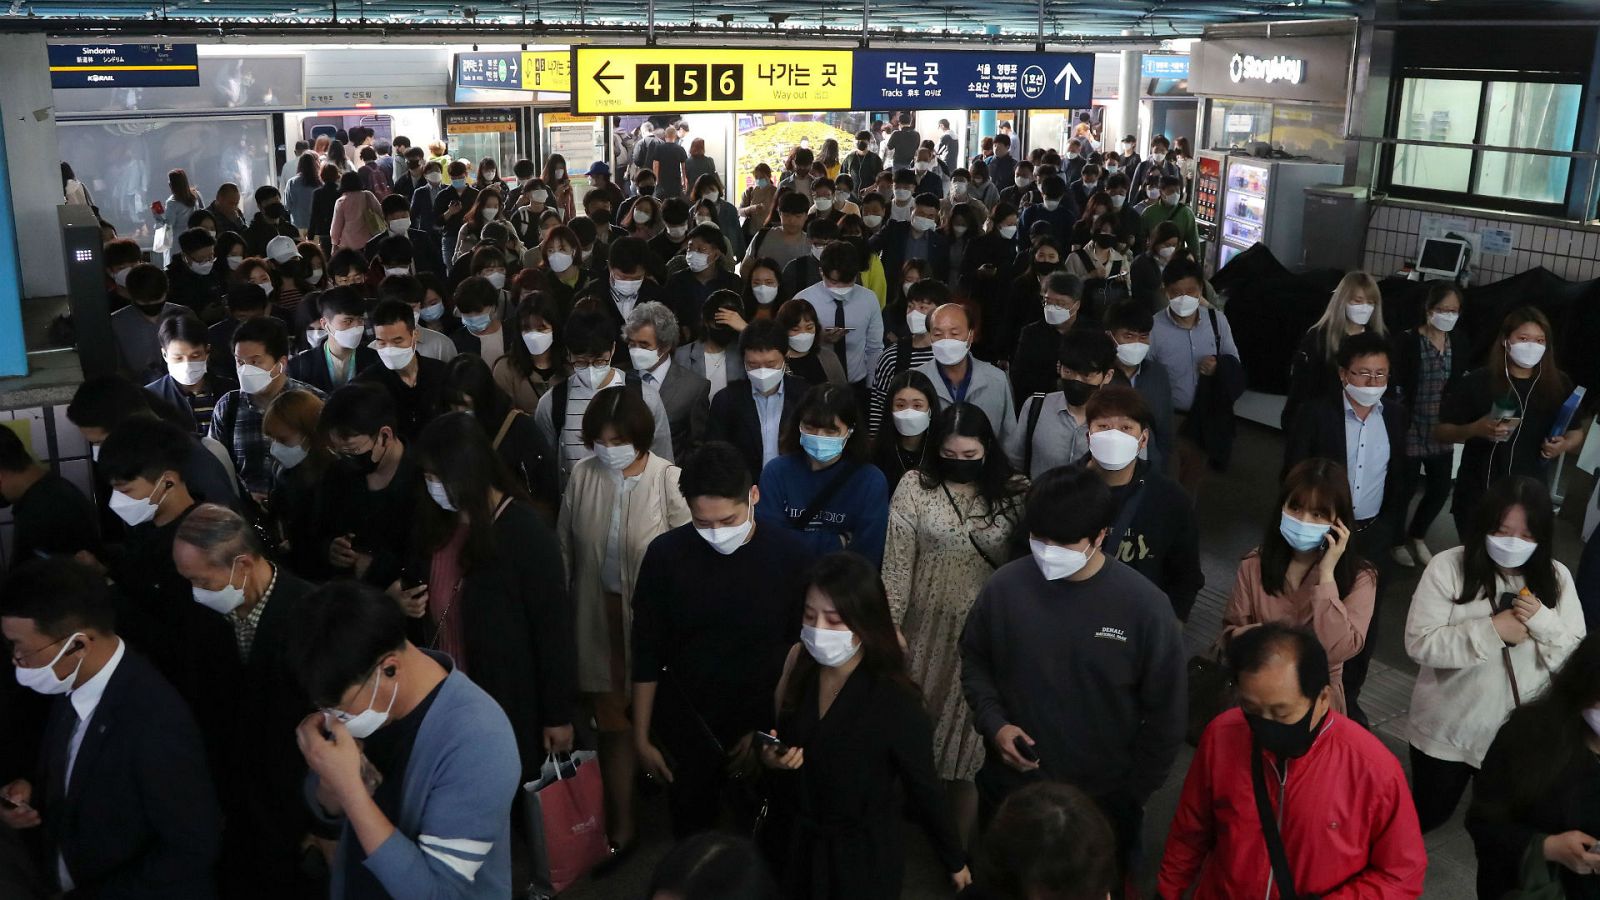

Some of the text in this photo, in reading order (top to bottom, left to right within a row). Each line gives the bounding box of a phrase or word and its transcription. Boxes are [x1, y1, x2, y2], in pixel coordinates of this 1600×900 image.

[82, 47, 116, 55] Sindorim
[885, 62, 939, 85] 타는 곳
[976, 63, 1018, 75] 서울 영등포
[758, 63, 837, 87] 나가는 곳
[1024, 74, 1044, 86] 1호선
[644, 69, 736, 96] 4 5 6
[968, 82, 1017, 93] 소요산 청량리
[773, 90, 807, 101] Way out
[881, 88, 903, 97] Tracks
[924, 89, 942, 97] のりば
[1102, 626, 1124, 636] DENALI
